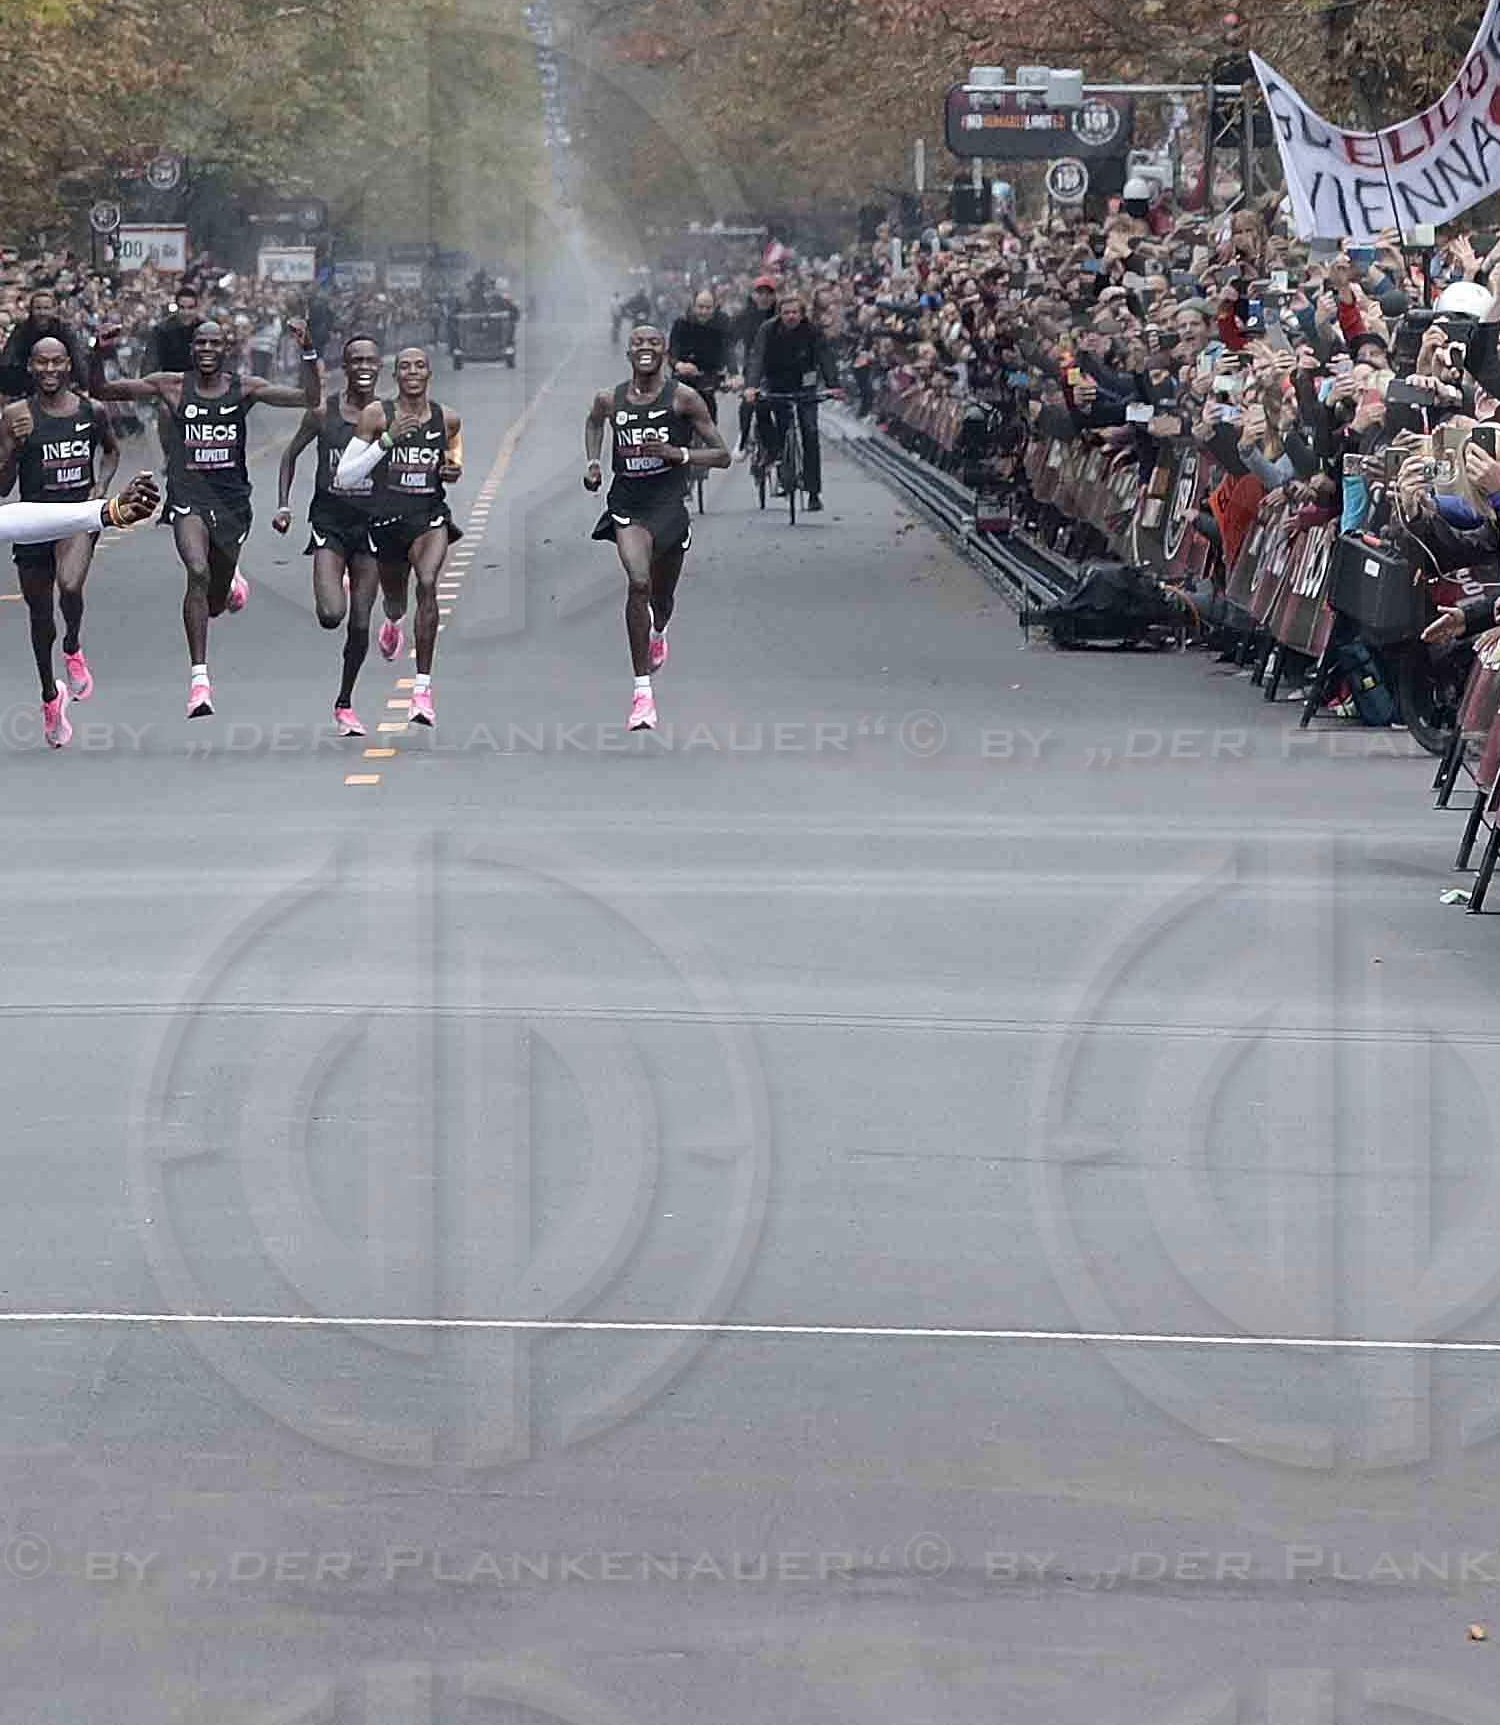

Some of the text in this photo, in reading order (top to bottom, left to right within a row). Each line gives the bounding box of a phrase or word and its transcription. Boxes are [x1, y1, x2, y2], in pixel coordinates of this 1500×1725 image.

[184, 423, 238, 442] INEOS
[616, 426, 670, 447] INEOS
[42, 439, 91, 461] INEOS
[391, 446, 440, 465] INEOS
